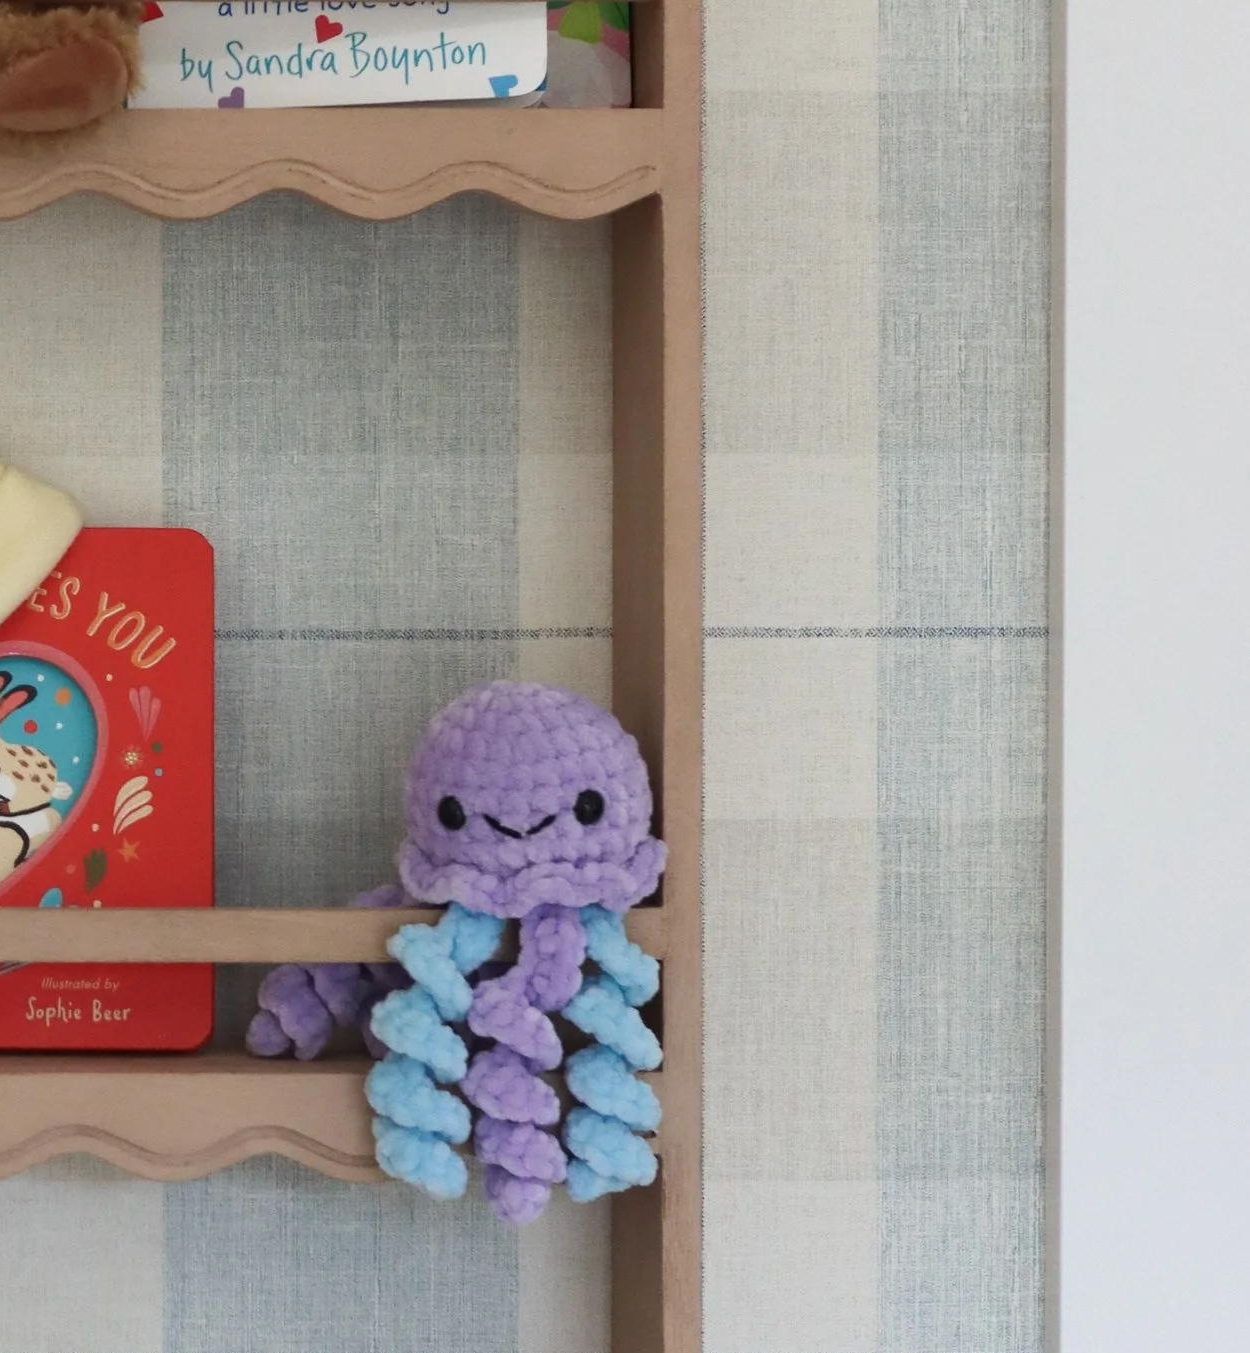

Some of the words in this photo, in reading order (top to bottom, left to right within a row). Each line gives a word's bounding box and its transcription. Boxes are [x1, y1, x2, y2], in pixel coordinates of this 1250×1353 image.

[180, 48, 213, 92] by
[225, 40, 338, 81] Sandra
[345, 31, 486, 85] Boynton
[85, 591, 177, 669] YOU
[41, 977, 102, 990] Illustrated
[105, 977, 121, 993] by
[25, 996, 82, 1026] Sophie
[92, 999, 132, 1022] Beer
